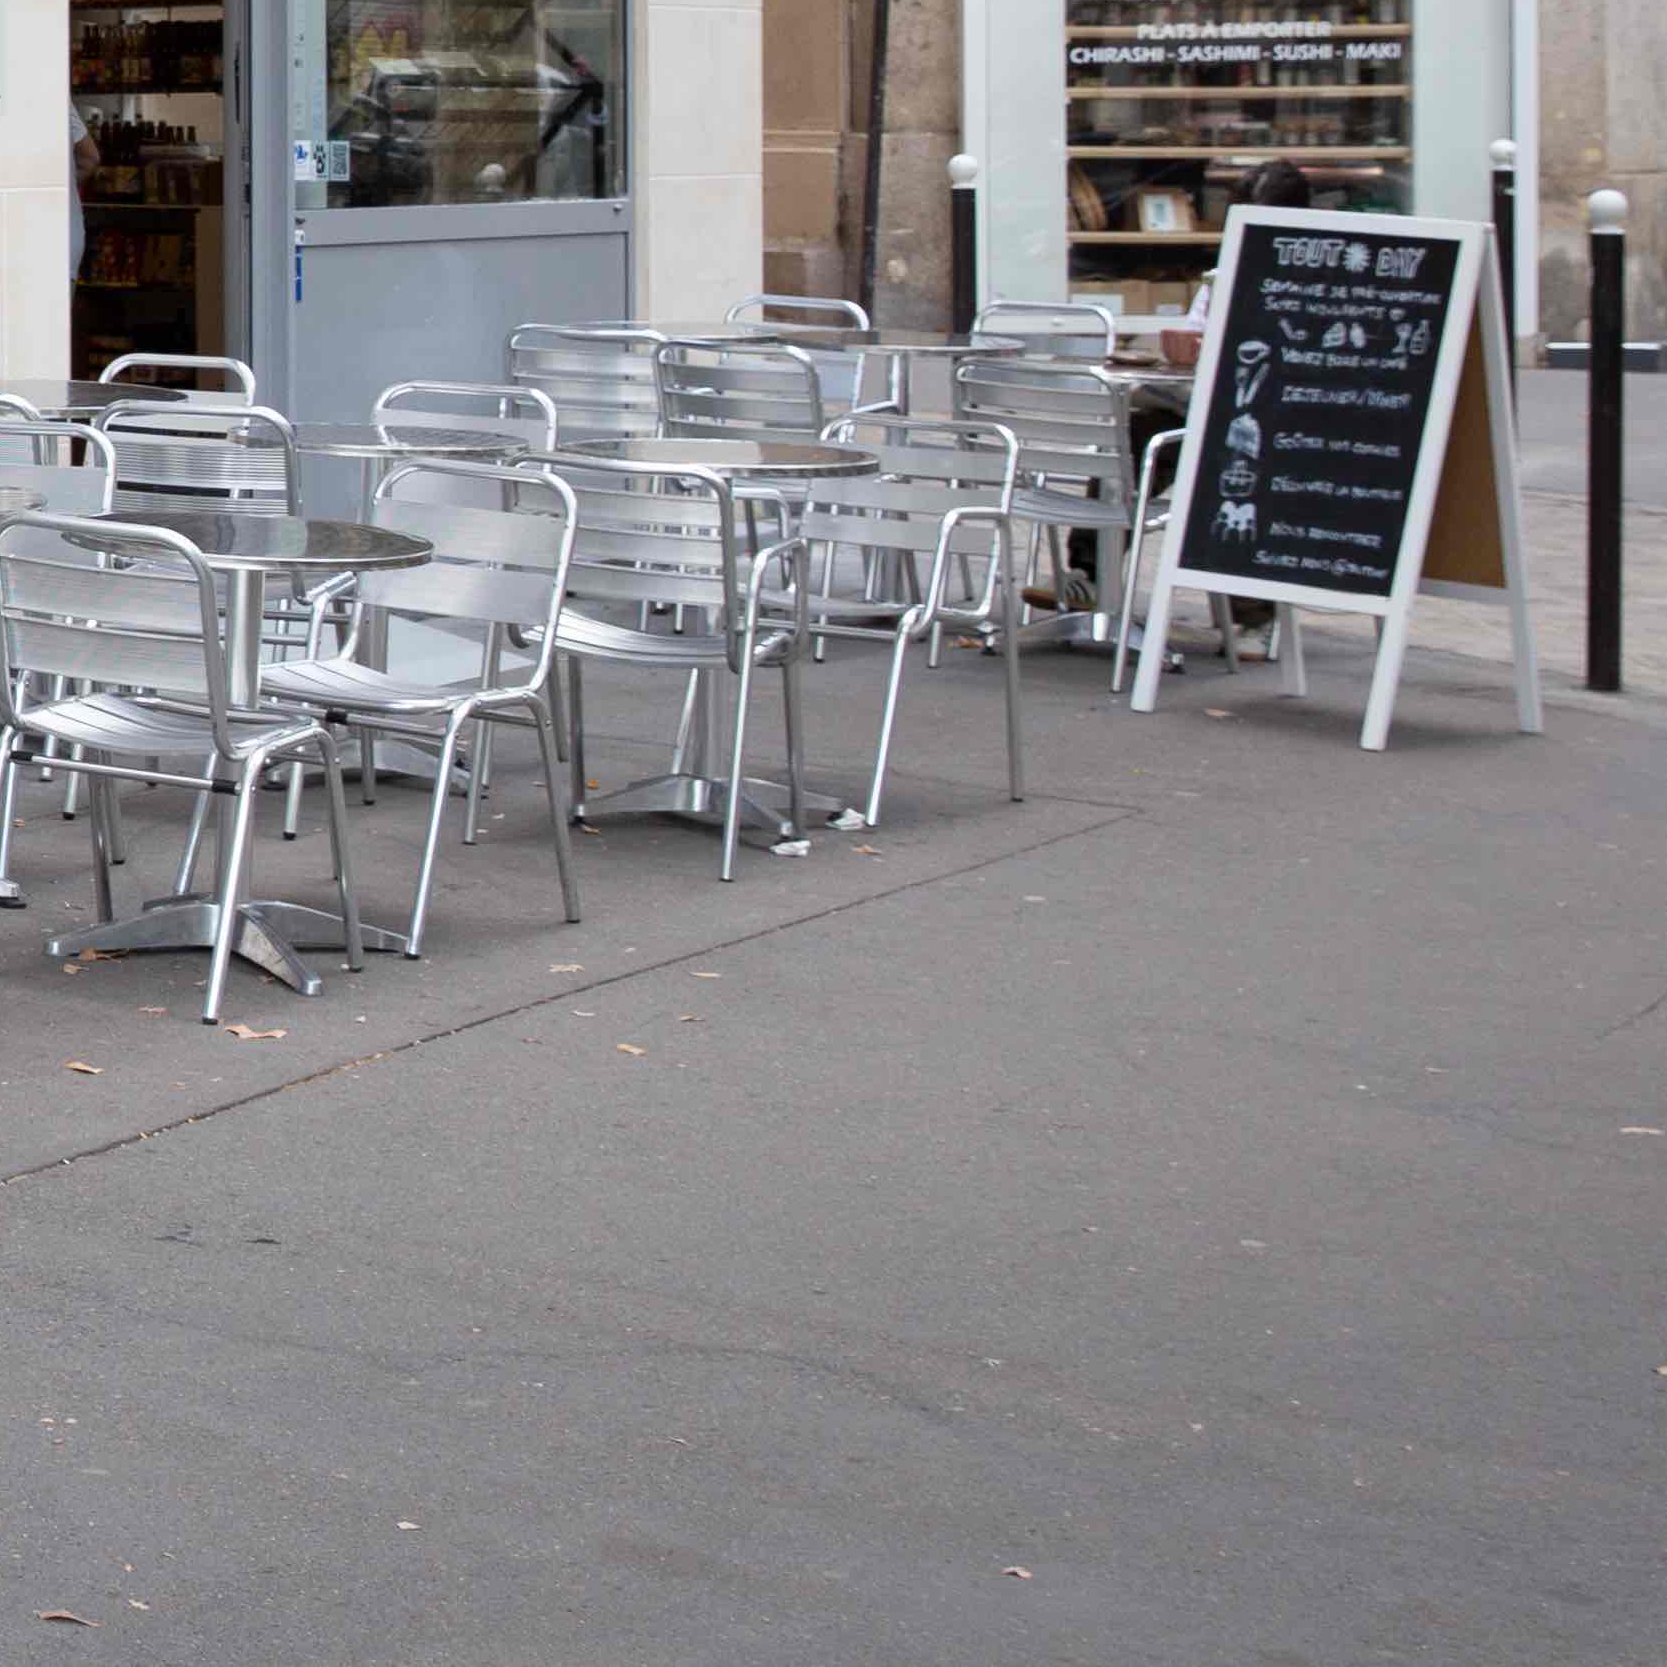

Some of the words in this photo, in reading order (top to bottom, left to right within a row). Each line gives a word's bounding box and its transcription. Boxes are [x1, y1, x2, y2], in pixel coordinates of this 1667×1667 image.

[1136, 23, 1197, 40] PLATS
[1220, 21, 1332, 39] EMPORTER
[1069, 46, 1166, 64] CHIRASHI
[1177, 45, 1261, 62] SASHIMI
[1272, 44, 1334, 61] SUSHI
[1345, 42, 1403, 60] MAKI
[1273, 236, 1346, 268] TOUT
[1375, 246, 1428, 280] DAY
